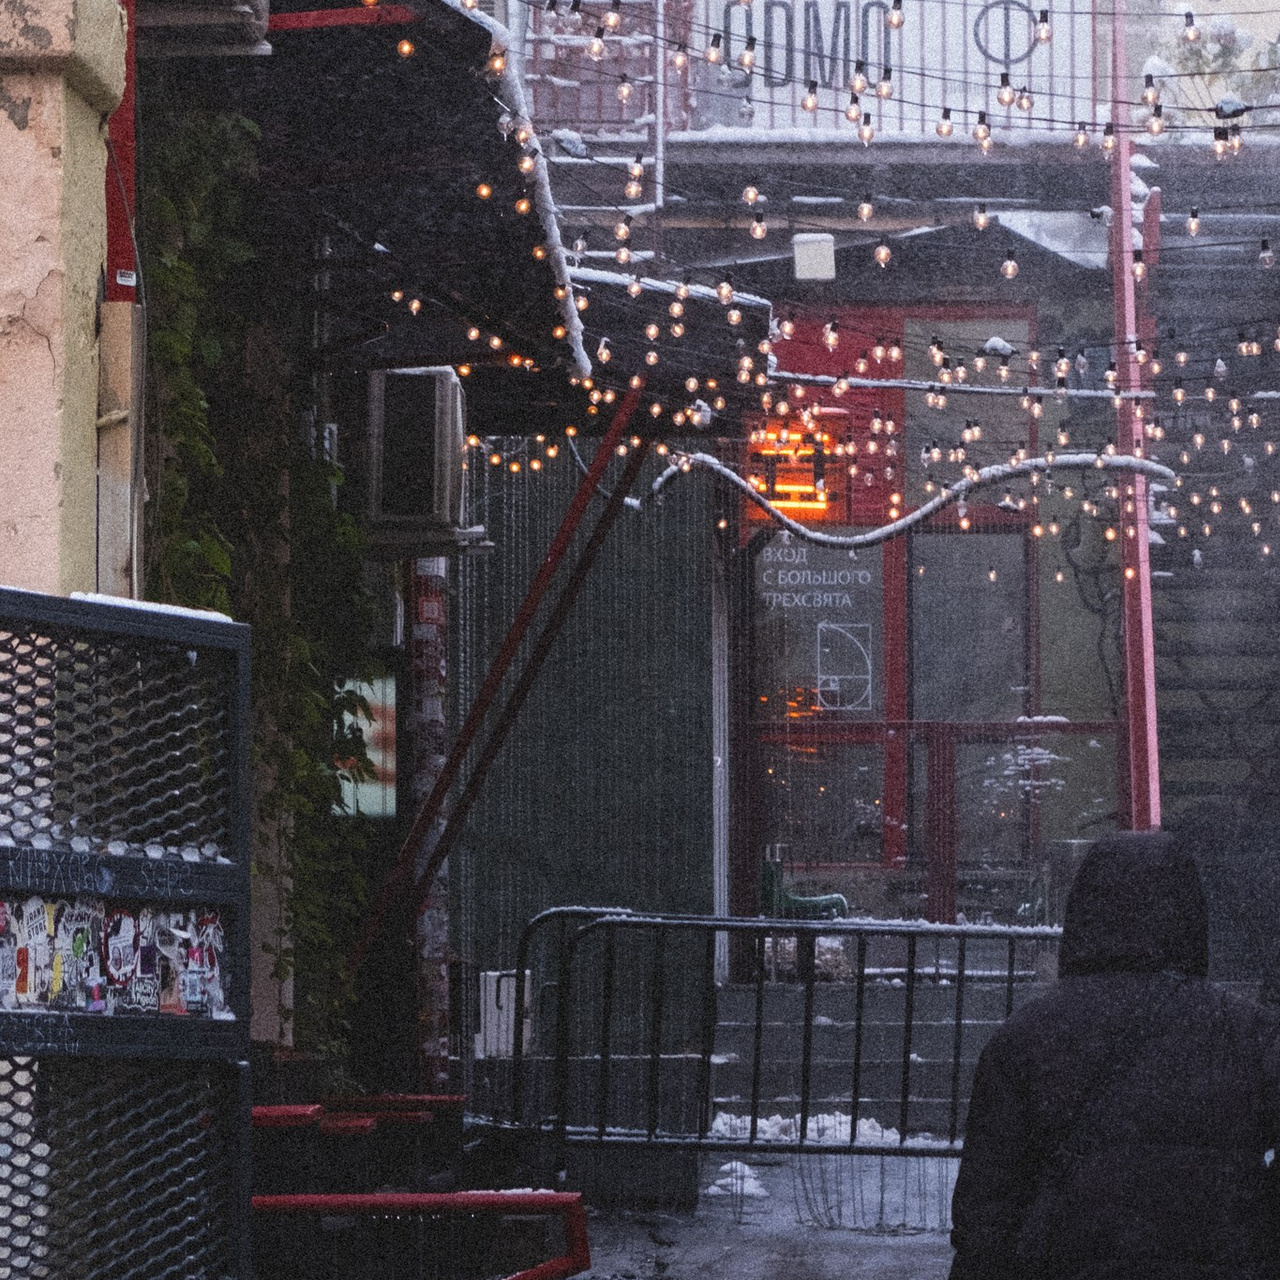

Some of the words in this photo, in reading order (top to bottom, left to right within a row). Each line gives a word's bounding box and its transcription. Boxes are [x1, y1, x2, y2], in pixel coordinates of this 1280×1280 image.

[762, 547, 808, 565] ВХОД
[762, 570, 774, 585] С
[777, 570, 872, 585] БОЛЬШОГО
[762, 592, 853, 608] ТРЕХСВЯТА
